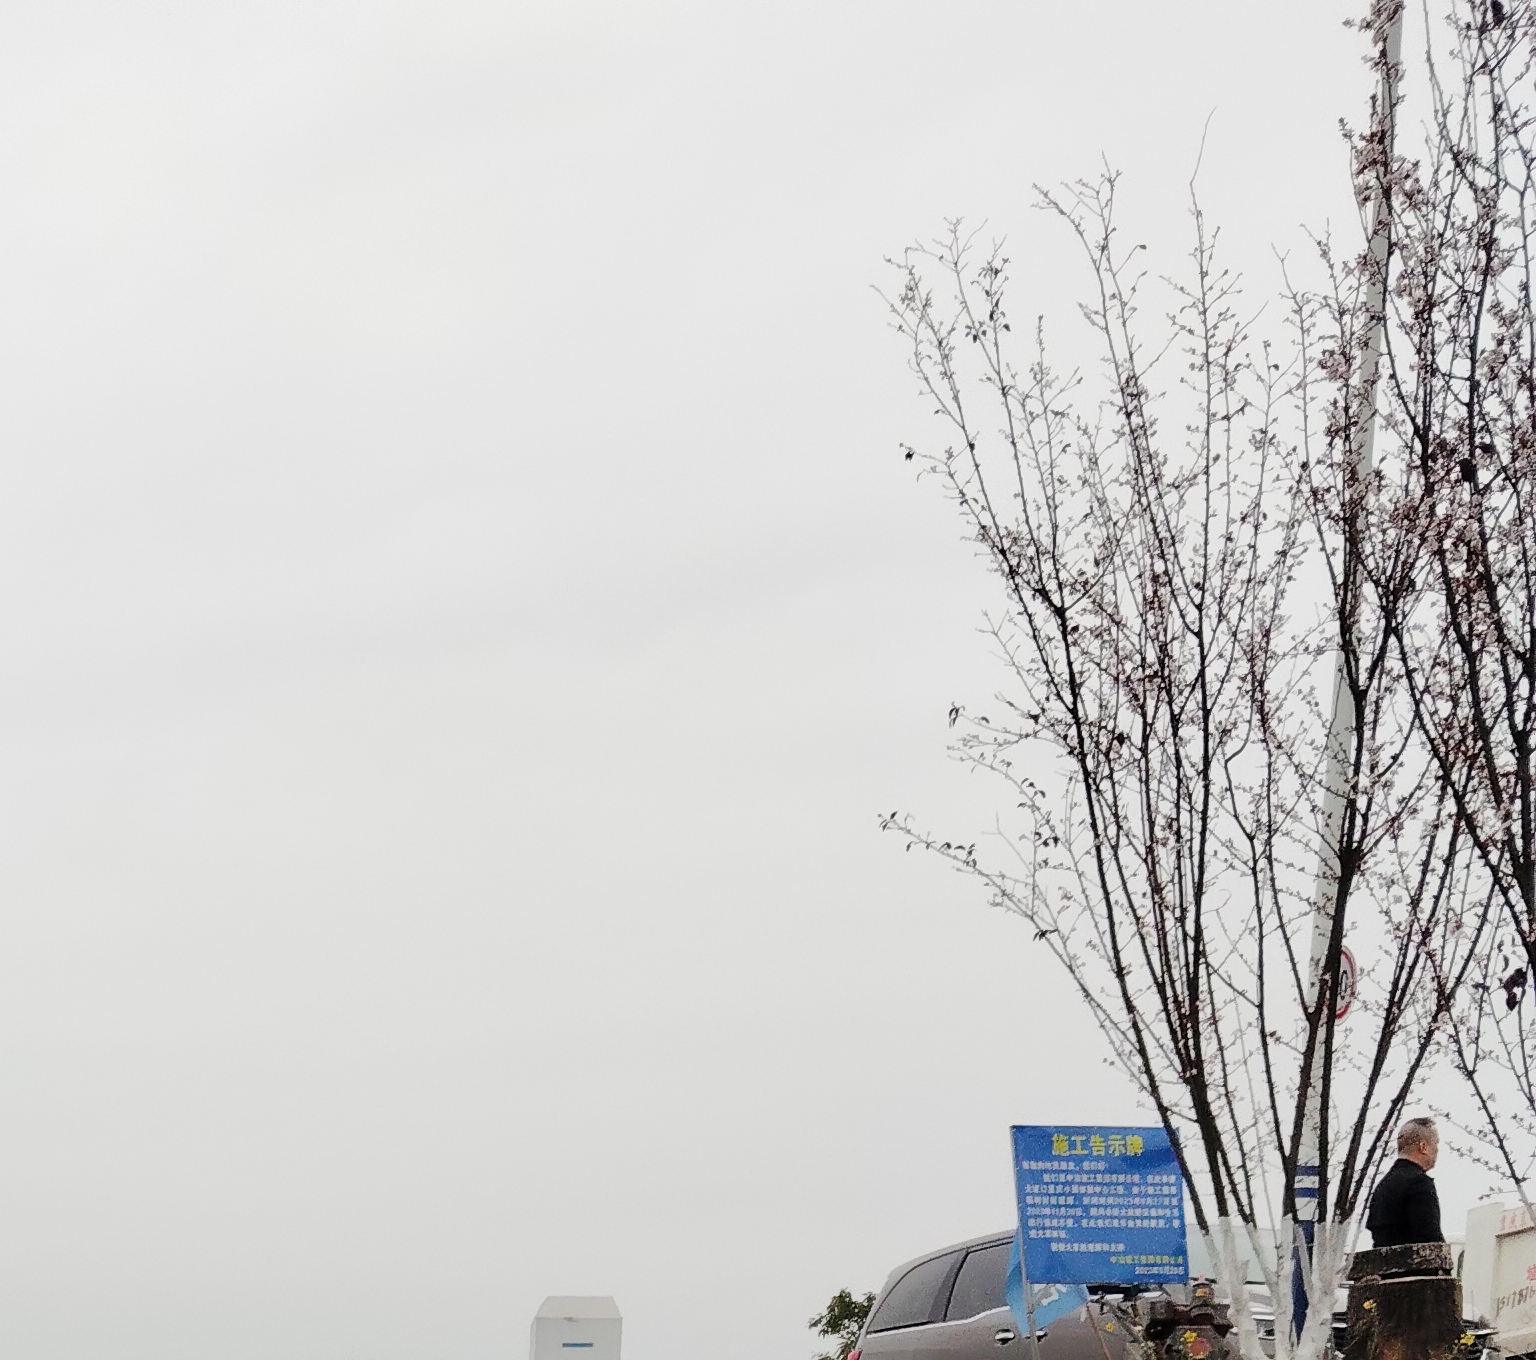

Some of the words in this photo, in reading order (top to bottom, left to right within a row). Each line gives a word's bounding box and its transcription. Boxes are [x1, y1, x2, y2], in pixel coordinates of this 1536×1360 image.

[1051, 1133, 1144, 1156] 施工告示牌
